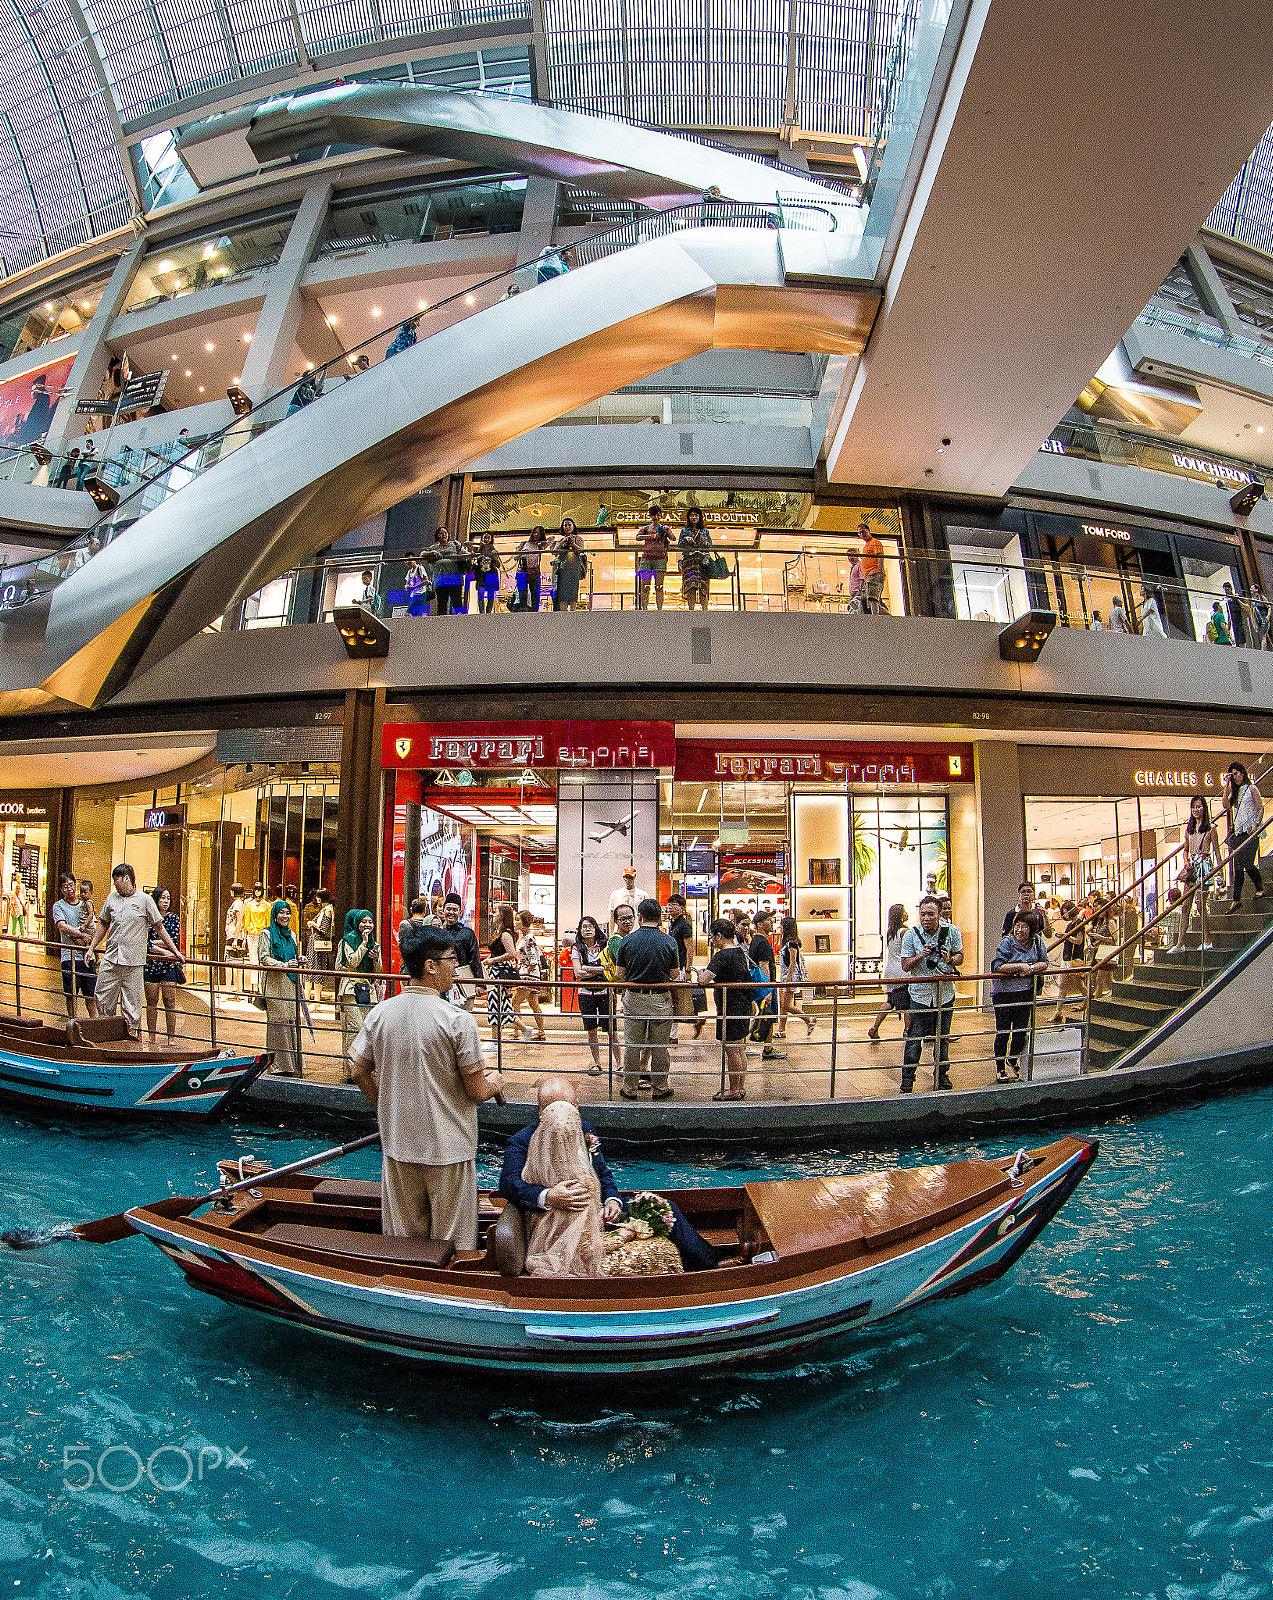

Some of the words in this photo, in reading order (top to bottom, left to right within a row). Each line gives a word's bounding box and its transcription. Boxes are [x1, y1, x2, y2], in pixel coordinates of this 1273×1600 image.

[1172, 453, 1251, 484] BOUCHERON
[1081, 525, 1104, 537] TOM
[1105, 527, 1131, 541] FORD
[428, 735, 544, 759] Ferrari
[558, 746, 649, 758] STORE
[715, 753, 822, 775] Ferrari
[833, 764, 910, 775] STORE
[1135, 771, 1197, 786] CHARLES
[1204, 772, 1214, 786] &
